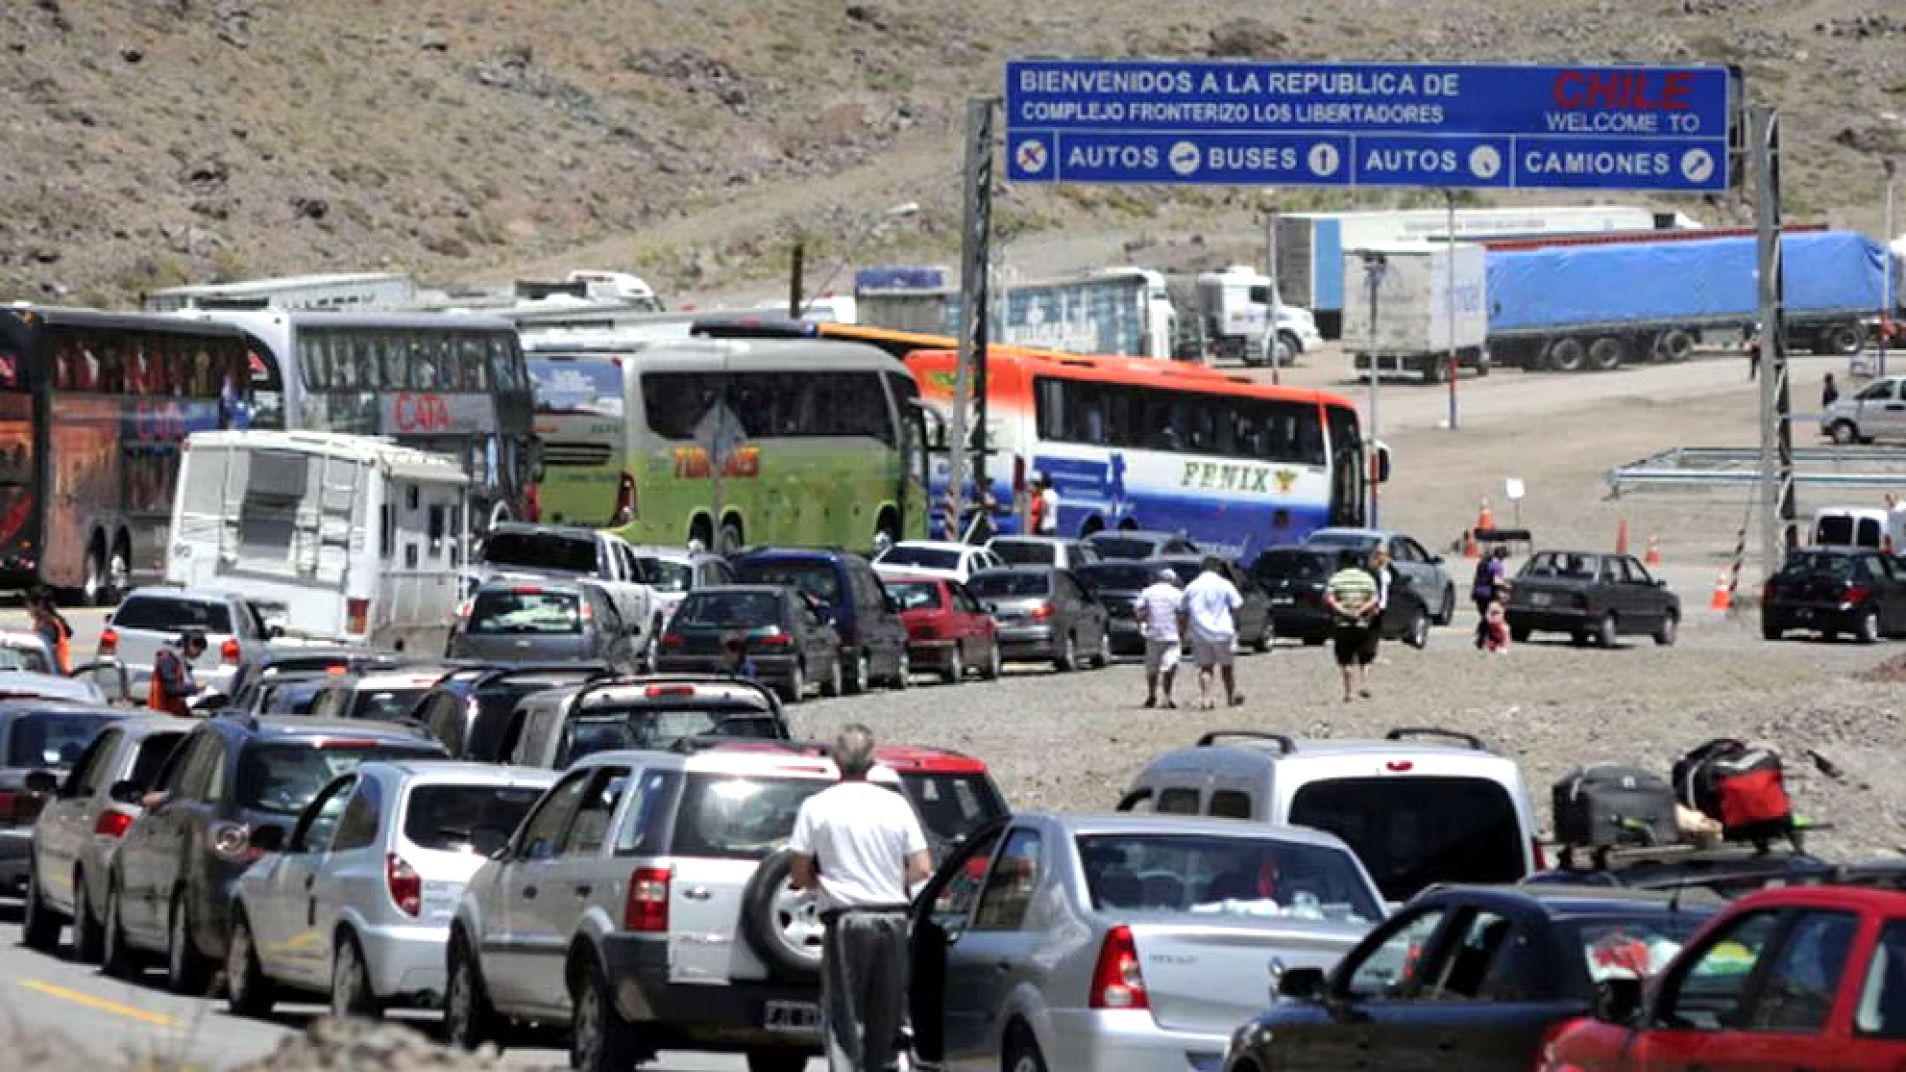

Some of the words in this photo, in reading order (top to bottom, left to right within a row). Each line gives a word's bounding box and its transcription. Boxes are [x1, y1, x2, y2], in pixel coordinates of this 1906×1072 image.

[1020, 70, 1192, 93] BIENVENIDOS
[1200, 72, 1219, 94] A
[1226, 73, 1260, 94] LA
[1269, 73, 1415, 95] REPUBLICA
[1424, 74, 1459, 96] DE
[1554, 70, 1697, 109] CHILE
[1022, 102, 1124, 121] COMPLEJO
[1129, 103, 1249, 122] FRONTERIZO
[1254, 104, 1292, 122] LOS
[1296, 104, 1444, 124] LIBERTADORES
[1546, 112, 1657, 132] WELCOME
[1668, 113, 1699, 133] TO
[1068, 146, 1159, 168] AUTOS
[1209, 147, 1297, 170] BUSES
[1365, 150, 1457, 172] AUTOS
[1525, 152, 1669, 175] CAMIONES
[394, 391, 454, 432] CATA
[1181, 461, 1269, 493] FENIX
